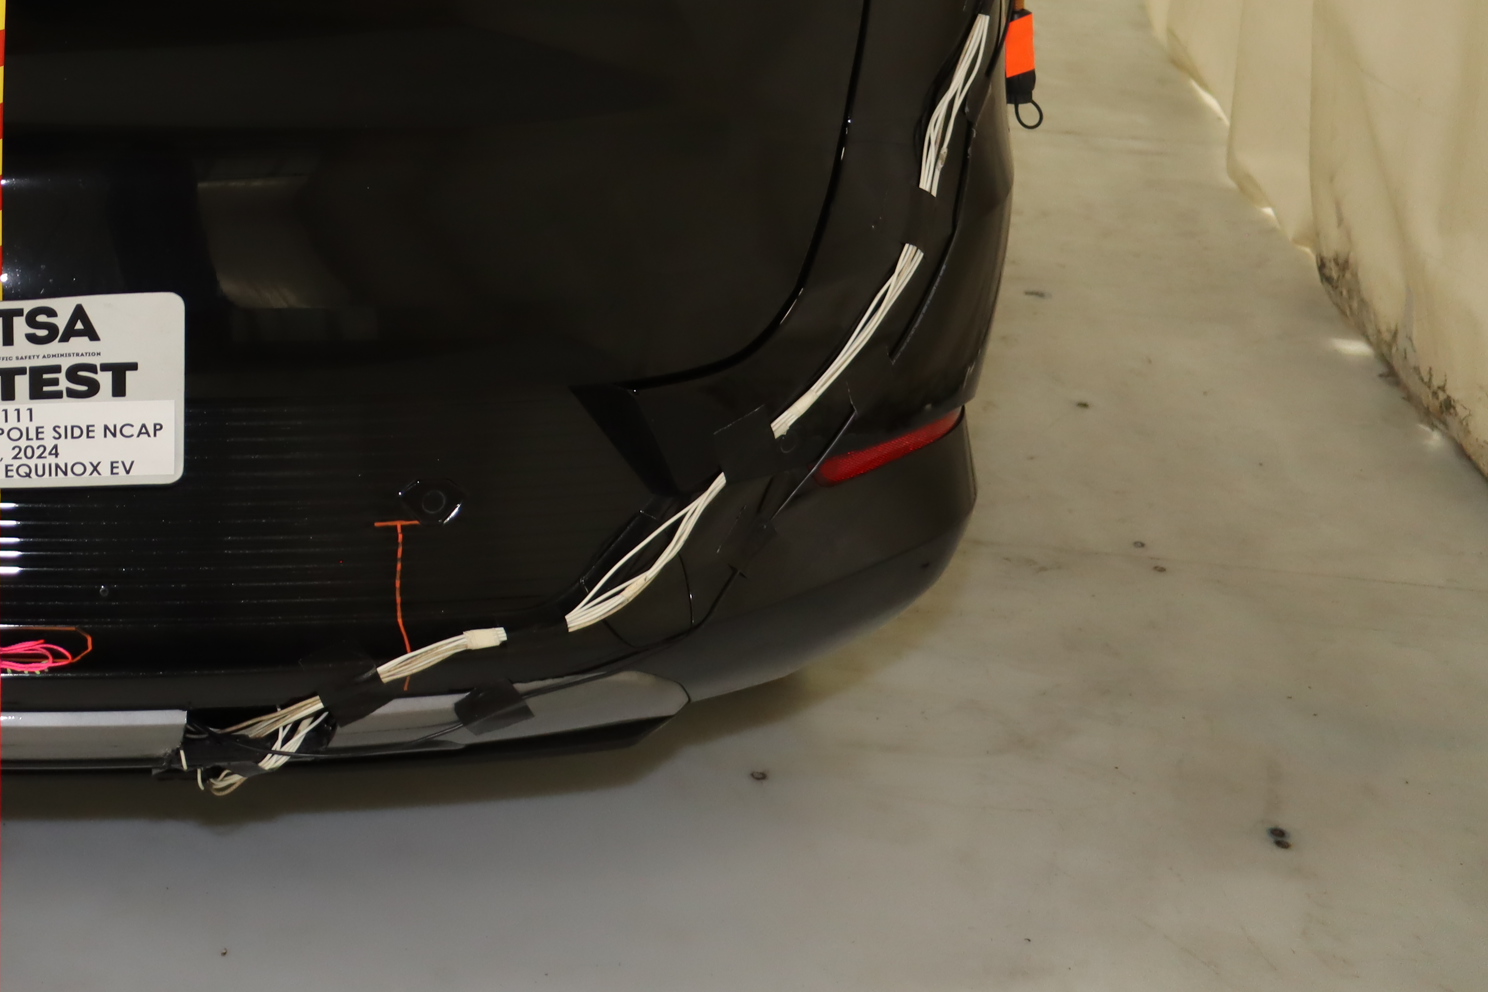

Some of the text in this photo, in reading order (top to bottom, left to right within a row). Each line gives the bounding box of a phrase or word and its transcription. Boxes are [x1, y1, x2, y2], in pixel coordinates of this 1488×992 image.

[53, 425, 95, 440] SIDE
[104, 423, 163, 438] NCAP
[12, 444, 59, 459] 2024
[5, 462, 101, 478] EQUINOX
[111, 461, 134, 475] EV
